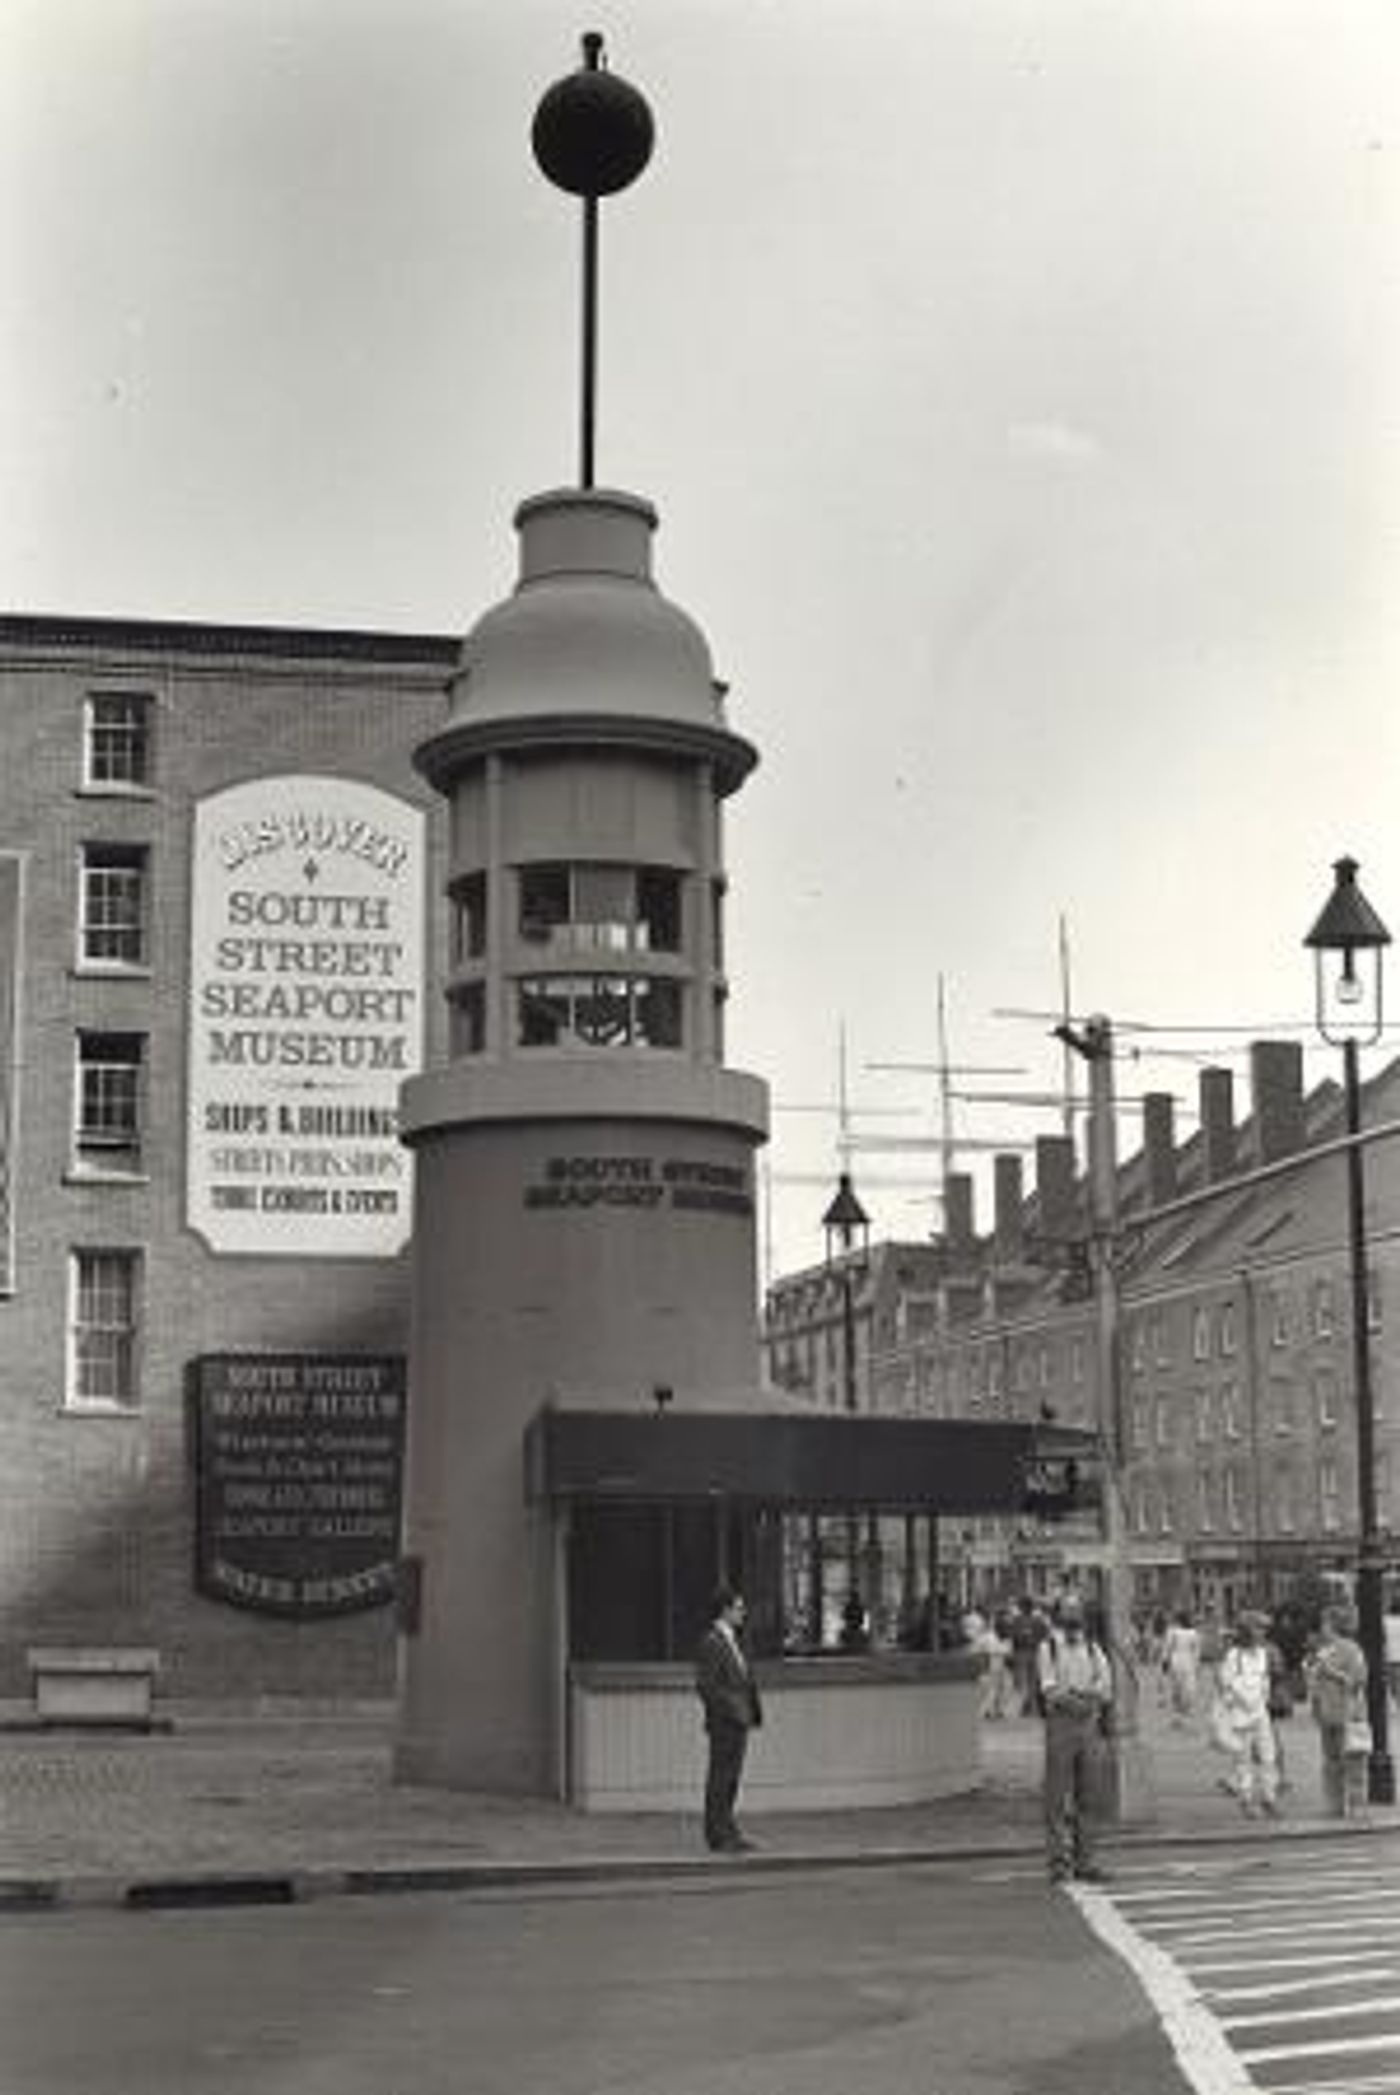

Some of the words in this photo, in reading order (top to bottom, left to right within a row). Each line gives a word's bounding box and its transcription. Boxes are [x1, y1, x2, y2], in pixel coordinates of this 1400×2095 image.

[228, 891, 390, 930] SOUTH
[217, 937, 404, 977] STREET
[200, 983, 416, 1022] SEAPORT
[208, 1030, 408, 1070] MUSEUM
[205, 1104, 269, 1134] SHIPS
[278, 1105, 296, 1135] &
[227, 1366, 296, 1389] SOUTH
